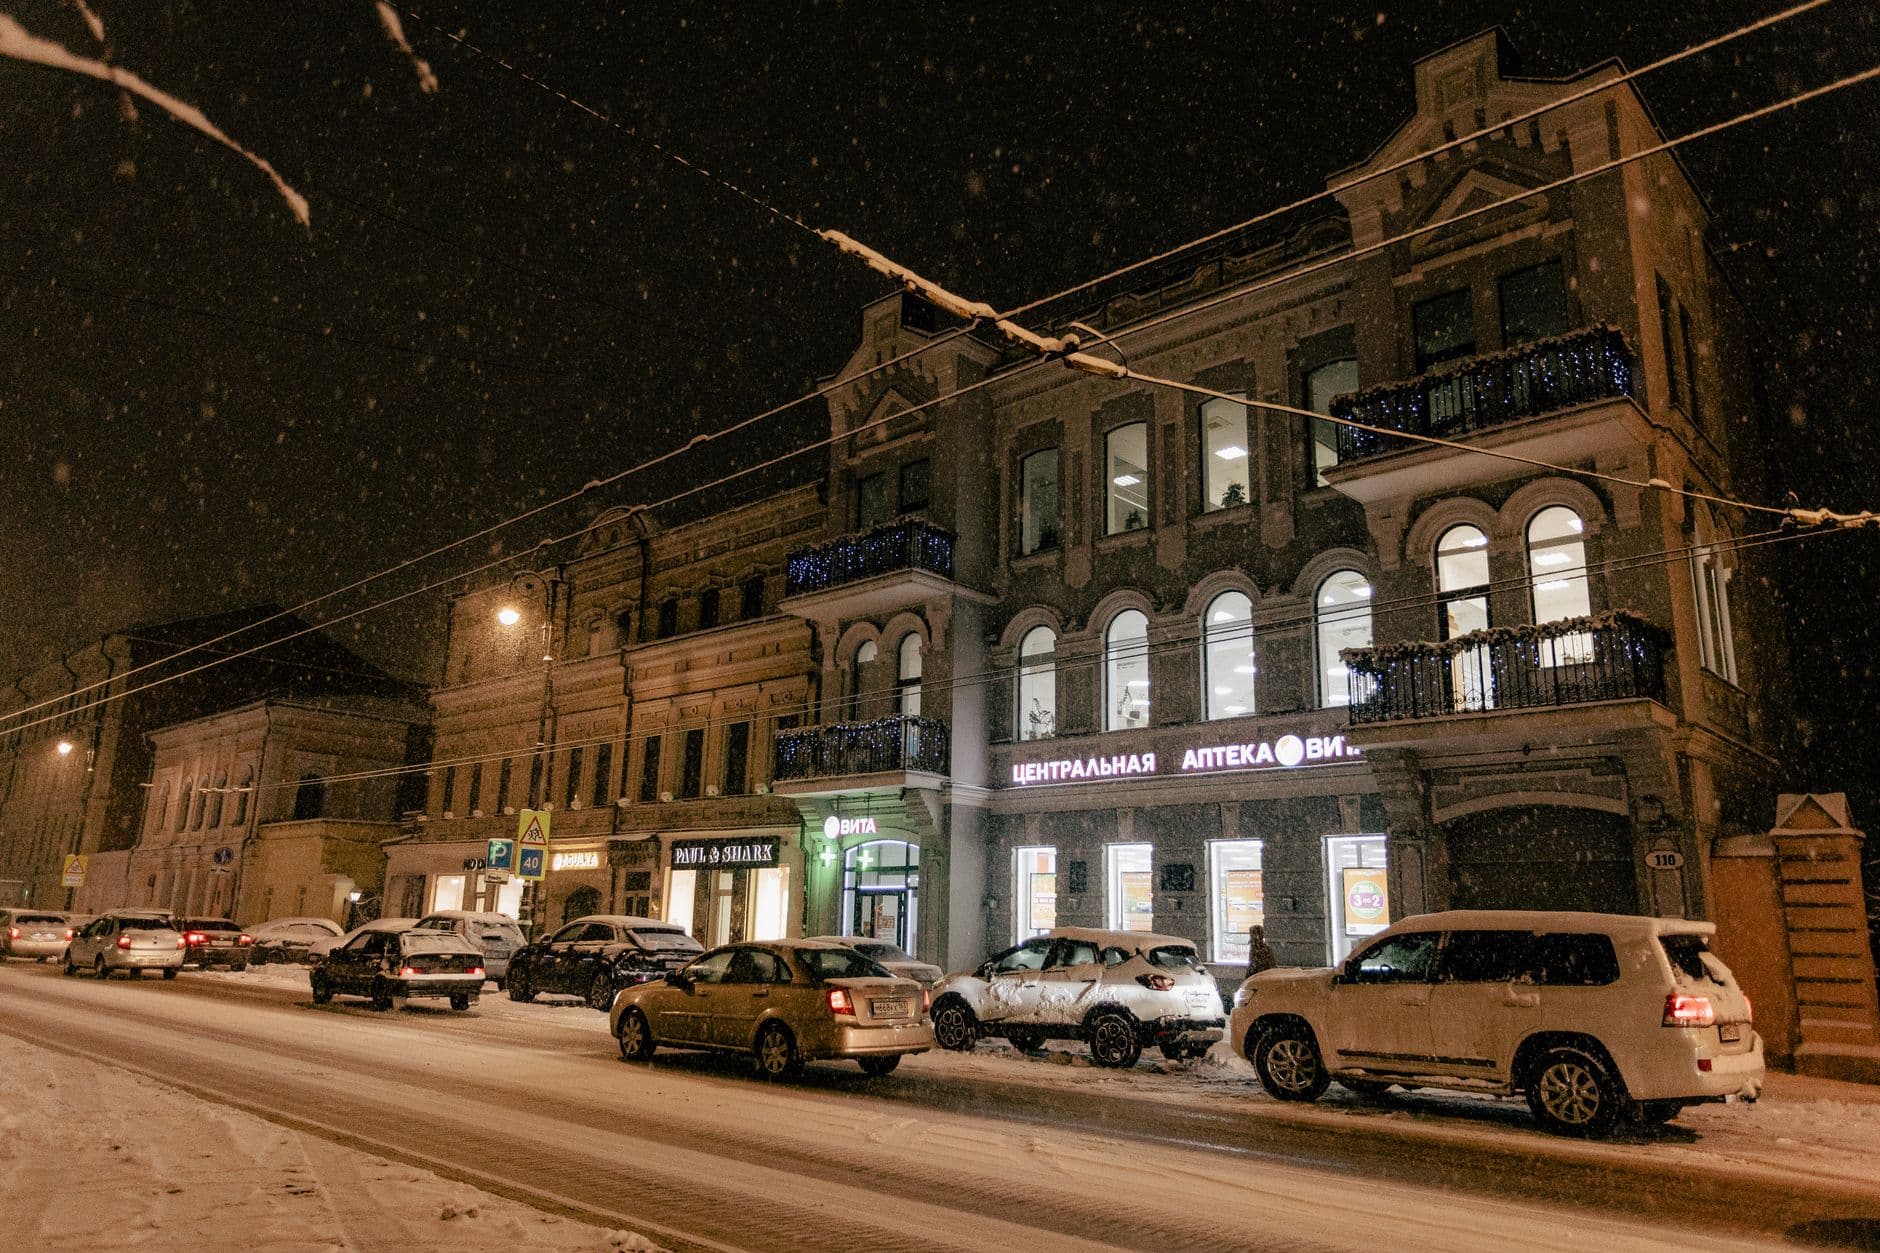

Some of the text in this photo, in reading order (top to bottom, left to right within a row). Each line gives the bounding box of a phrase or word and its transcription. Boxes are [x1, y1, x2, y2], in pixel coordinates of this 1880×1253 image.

[1012, 752, 1156, 785] ЦЕНТРАЛЬНАЯ
[1182, 742, 1274, 769] АПТЕКА
[839, 817, 877, 835] ВИТА
[675, 844, 773, 864] PAUL & SHARK
[1655, 854, 1675, 866] 110
[523, 856, 539, 868] 40
[1353, 895, 1362, 906] 3
[1372, 895, 1380, 907] 2
